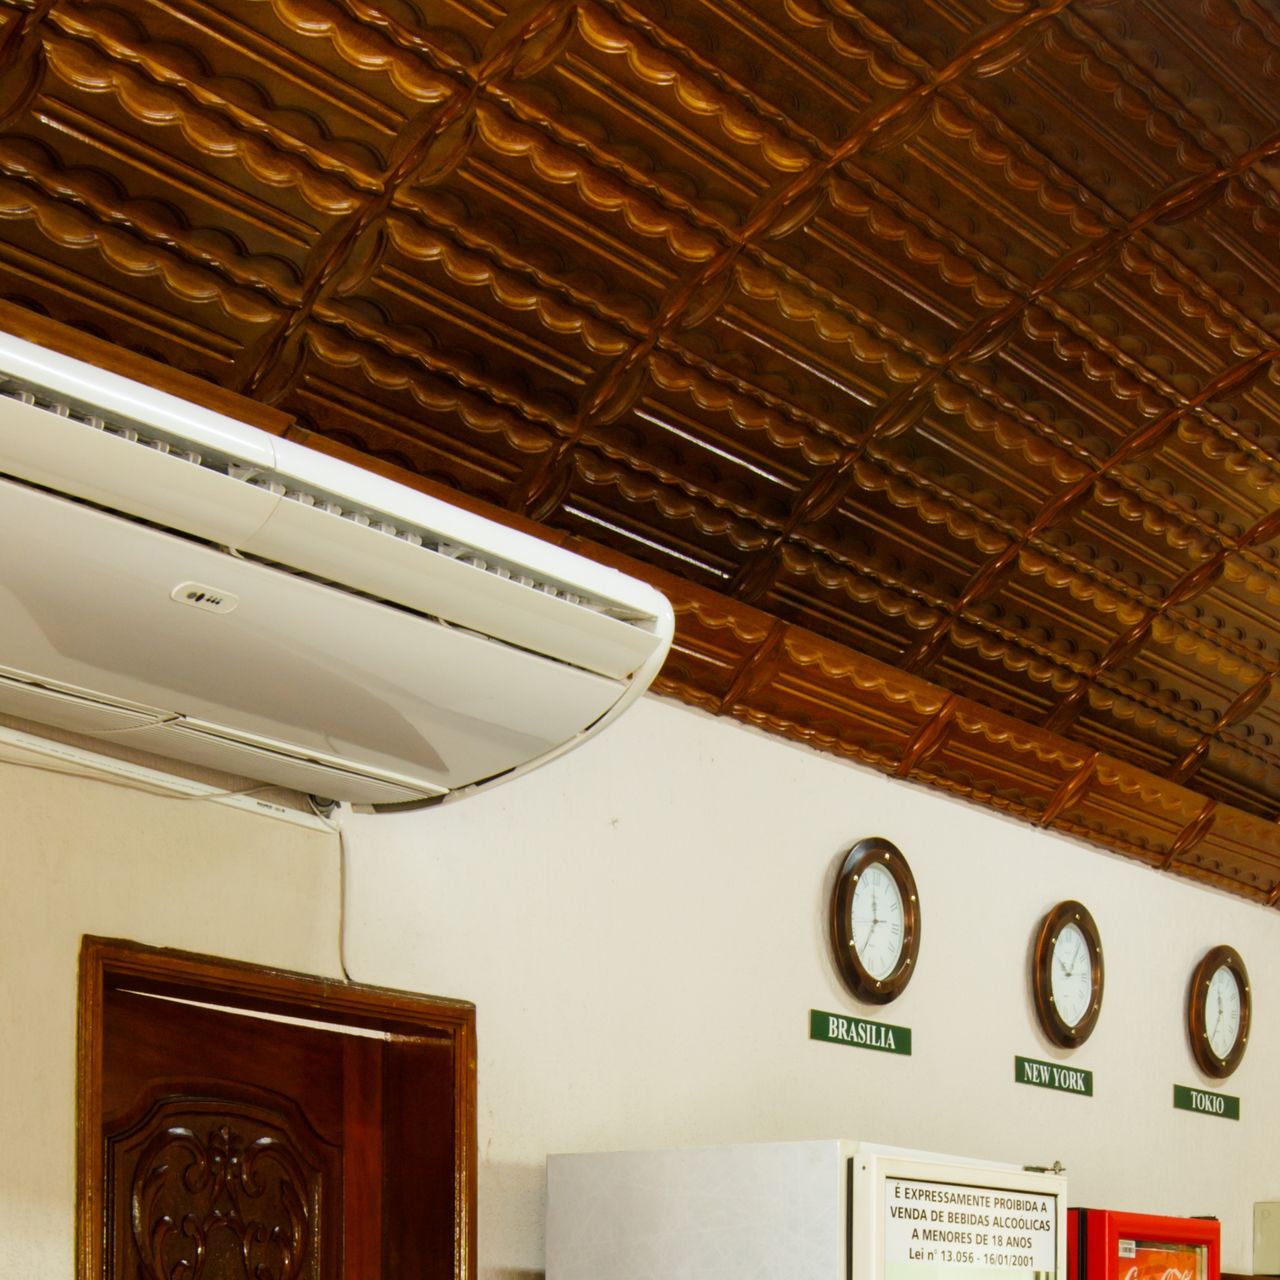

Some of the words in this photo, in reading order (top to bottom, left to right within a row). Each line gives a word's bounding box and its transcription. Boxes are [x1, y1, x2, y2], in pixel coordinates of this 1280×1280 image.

[828, 1017, 895, 1049] BRASILIA
[1024, 1062, 1050, 1085] NEW
[1053, 1067, 1085, 1091] YORK
[1191, 1091, 1224, 1114] TOKIO
[895, 1183, 900, 1198] É
[905, 1188, 991, 1207] EXPRESSAMENTE
[994, 1197, 1038, 1211] PROIBIDA
[1041, 1202, 1047, 1213] A
[890, 1206, 927, 1221] VENDA
[931, 1211, 944, 1222] DE
[948, 1212, 989, 1227] BEBIDAS
[993, 1216, 1050, 1232] ALCOÓLICAS
[912, 1229, 919, 1240] A
[923, 1230, 972, 1244] MENORES
[976, 1234, 988, 1245] DE
[992, 1235, 1002, 1246] 18
[1007, 1236, 1032, 1248] ANOS
[909, 1248, 924, 1260] Lei
[941, 1250, 974, 1263] 13.056
[984, 1254, 1034, 1267] 16/01/2001
